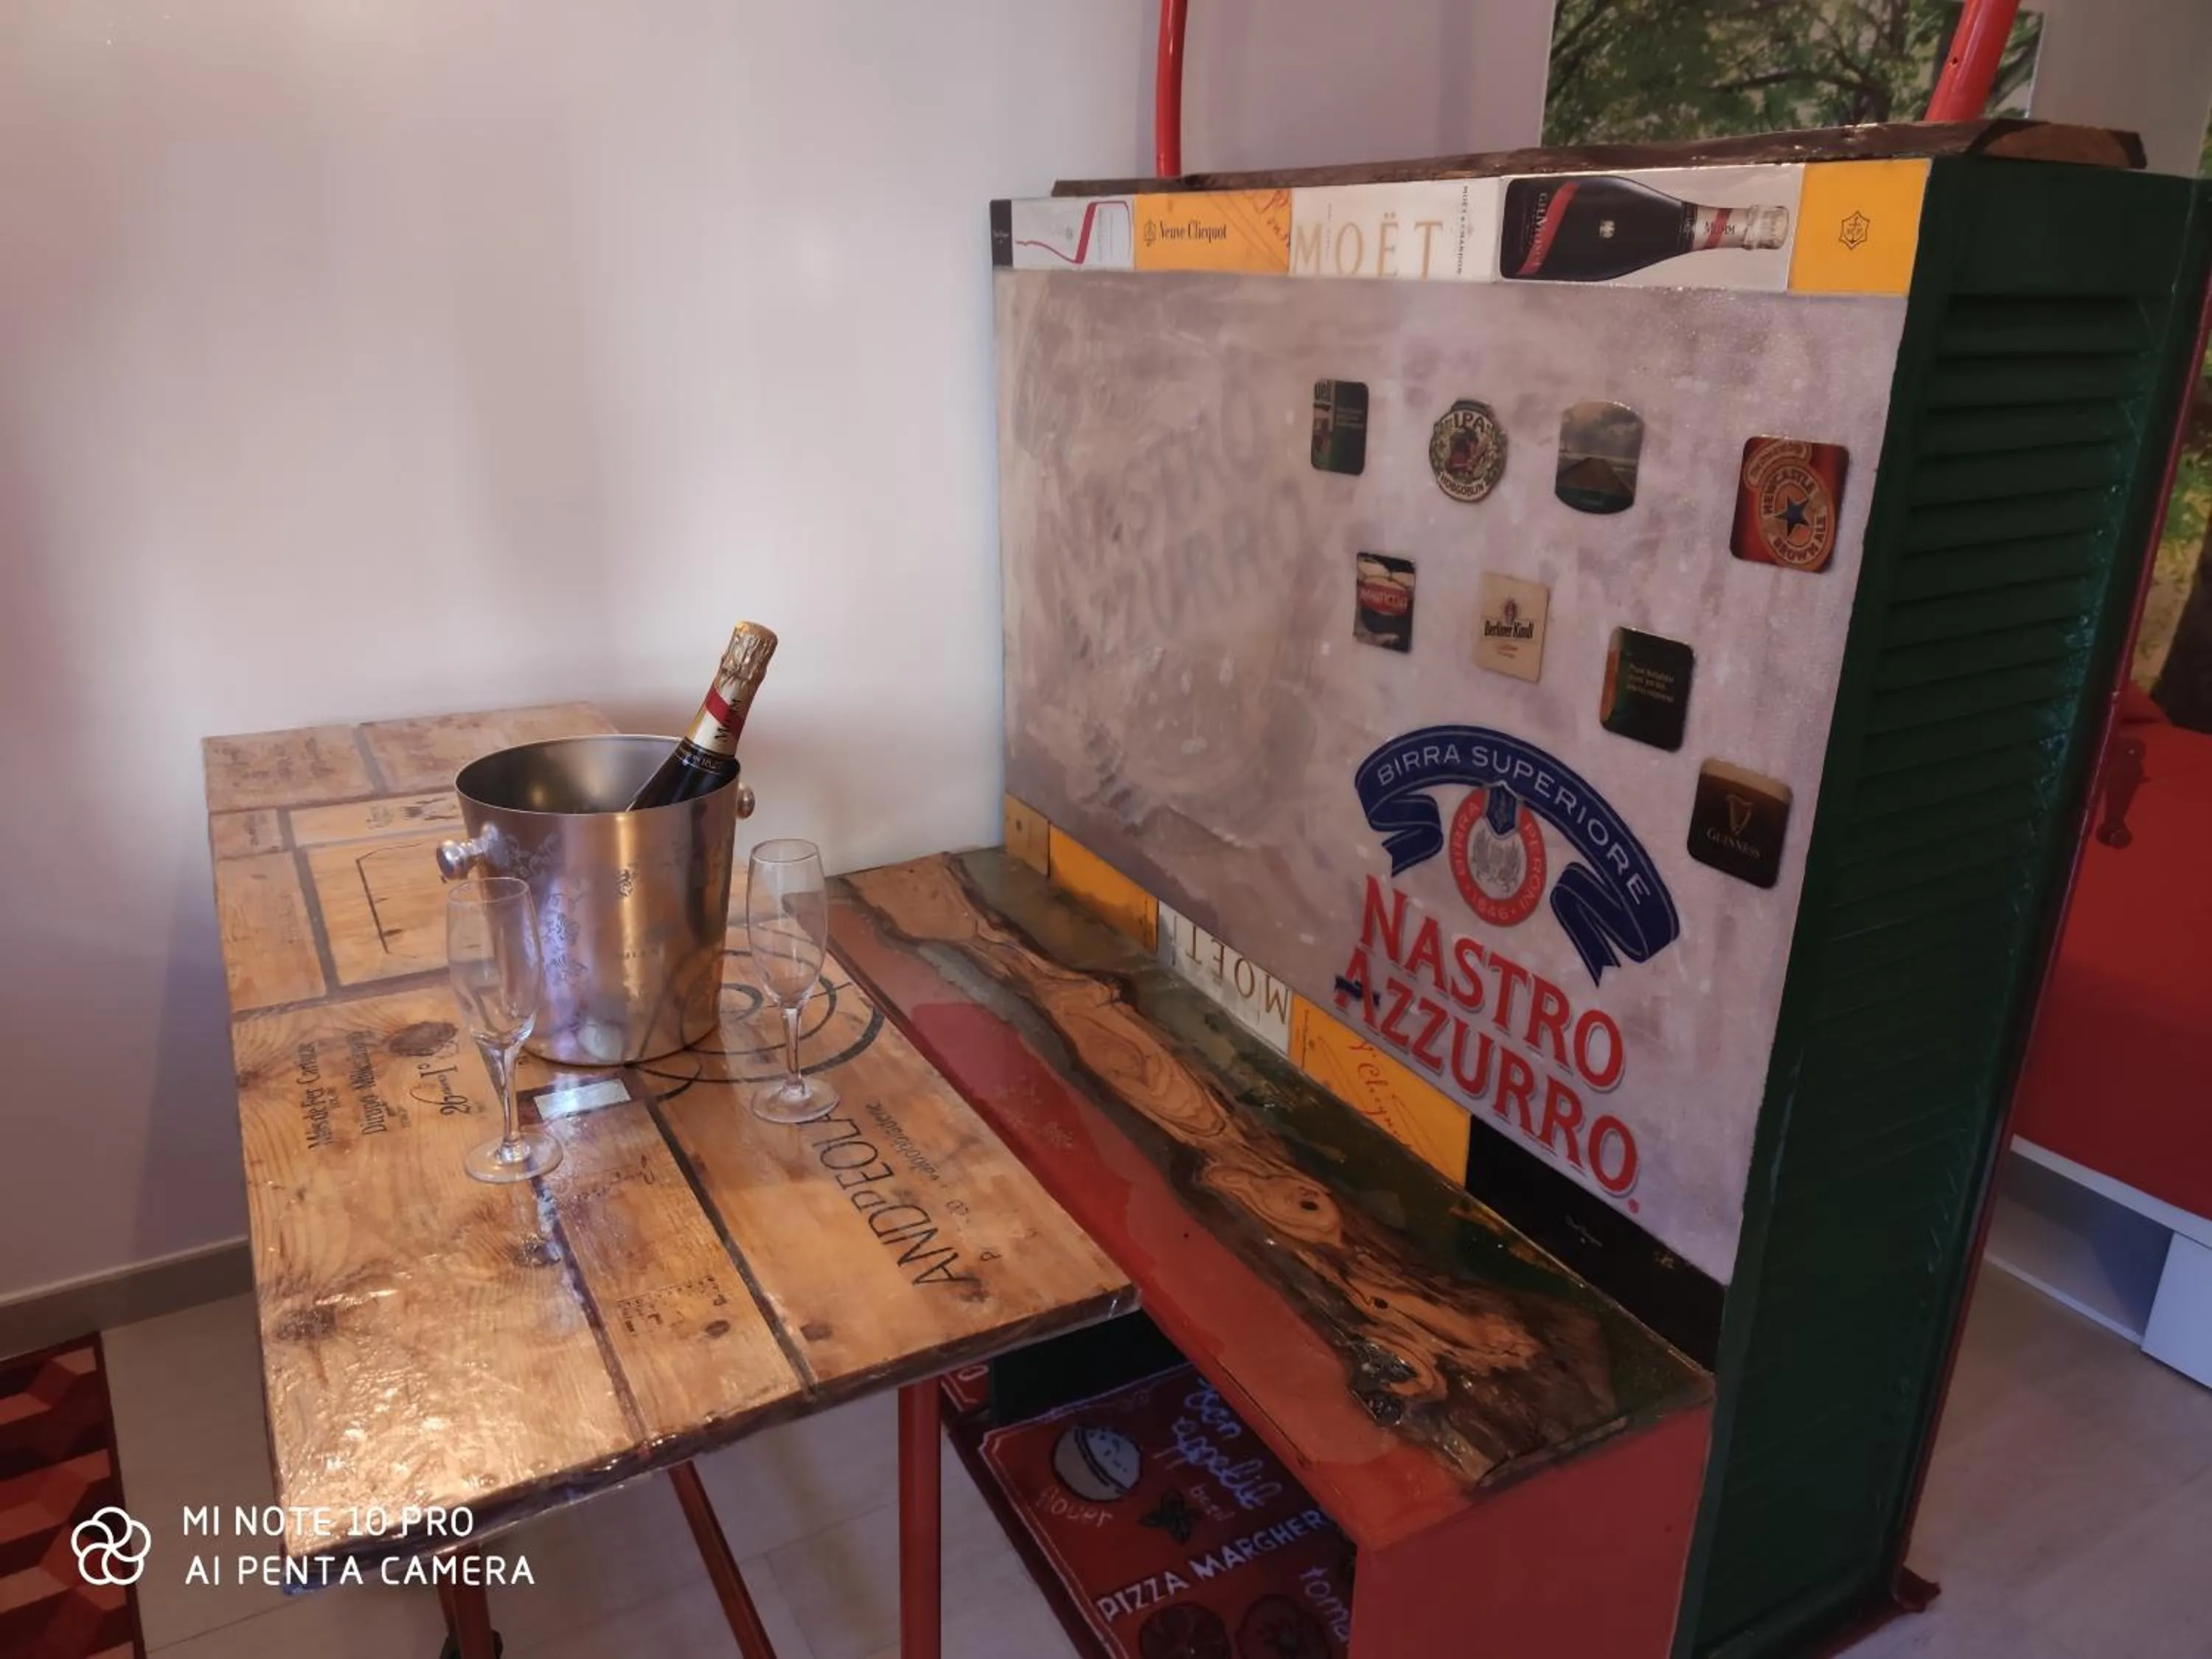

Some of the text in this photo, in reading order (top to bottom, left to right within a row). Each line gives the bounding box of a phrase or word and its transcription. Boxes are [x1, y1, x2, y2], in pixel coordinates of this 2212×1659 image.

[1188, 219, 1228, 244] Clicquot
[1376, 742, 1652, 908] BIRRA SUPERIORE
[1359, 873, 1624, 1091] NASTRO
[1333, 945, 1638, 1197] AZZURRO
[1096, 1509, 1327, 1623] PIZZA MARGHER
